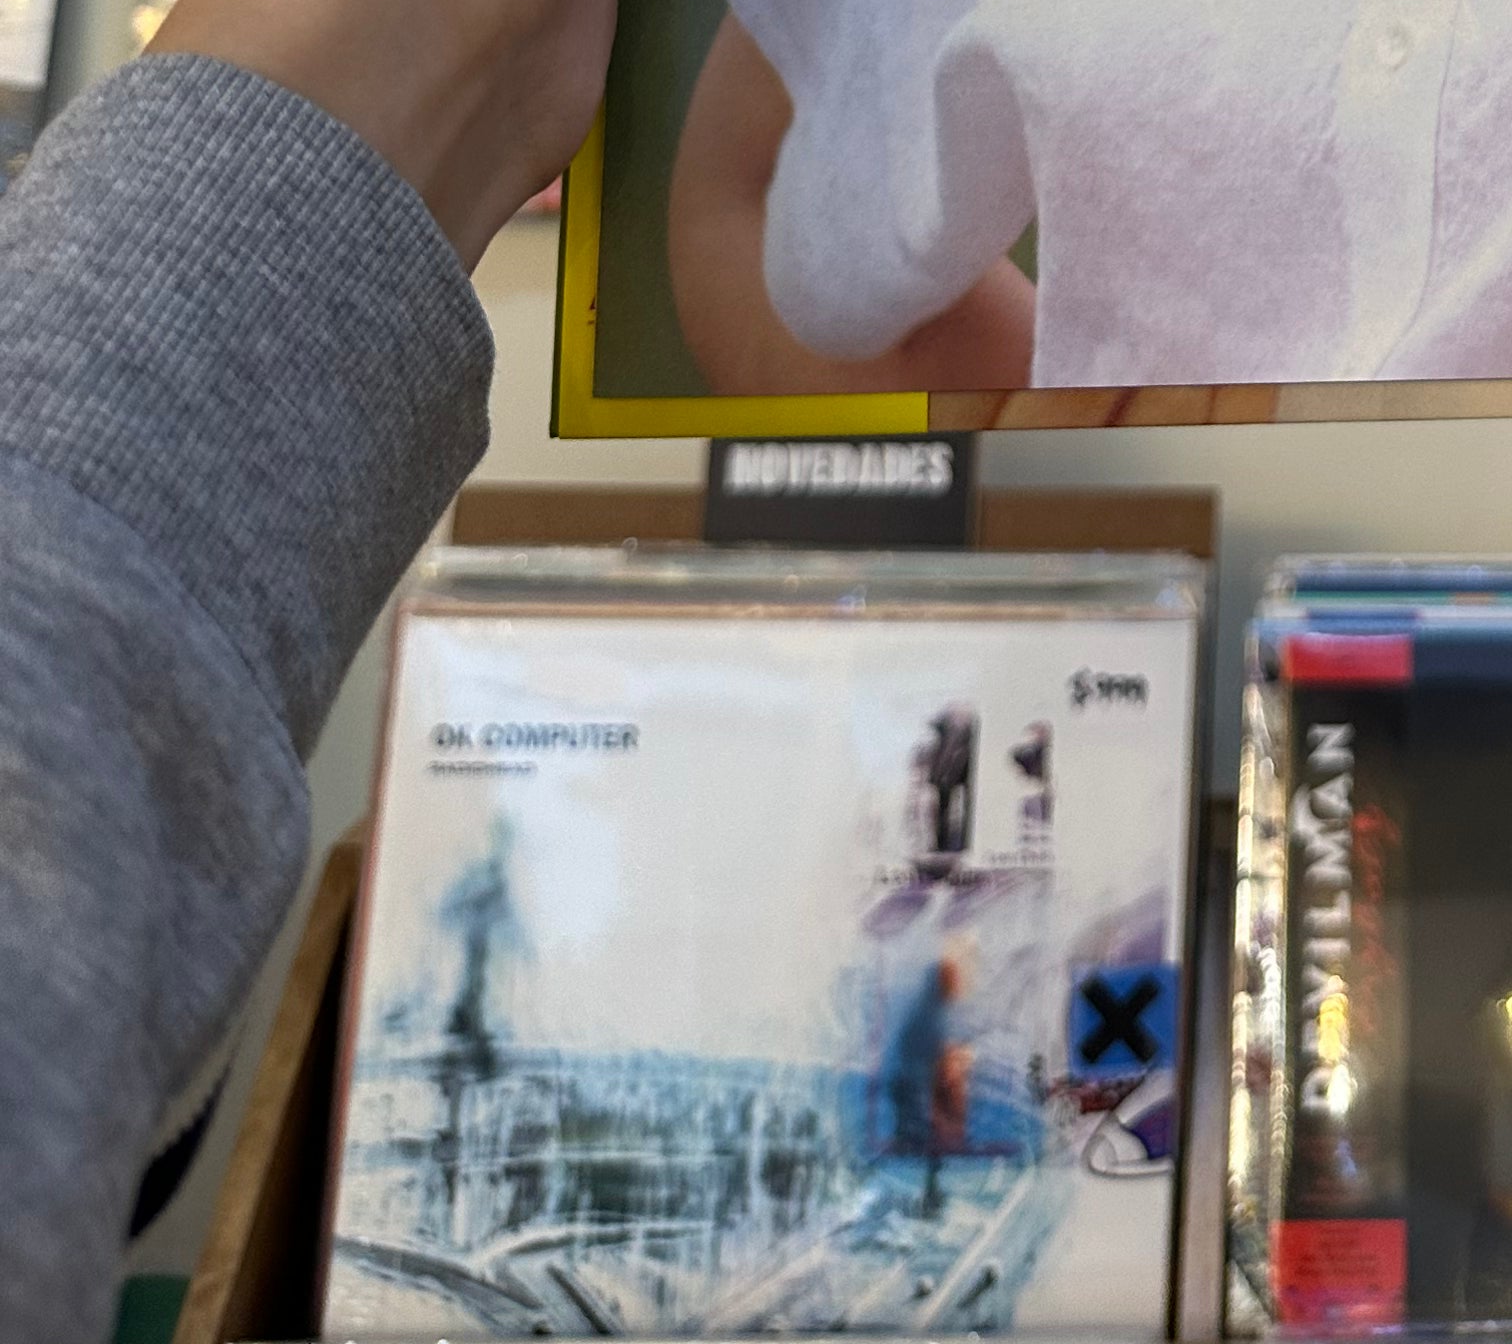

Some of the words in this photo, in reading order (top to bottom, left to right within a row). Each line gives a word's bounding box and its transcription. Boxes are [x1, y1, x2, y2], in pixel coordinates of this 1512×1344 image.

[723, 440, 954, 496] NOVEDADES
[429, 722, 472, 751] OK
[476, 721, 641, 753] COMPUTER
